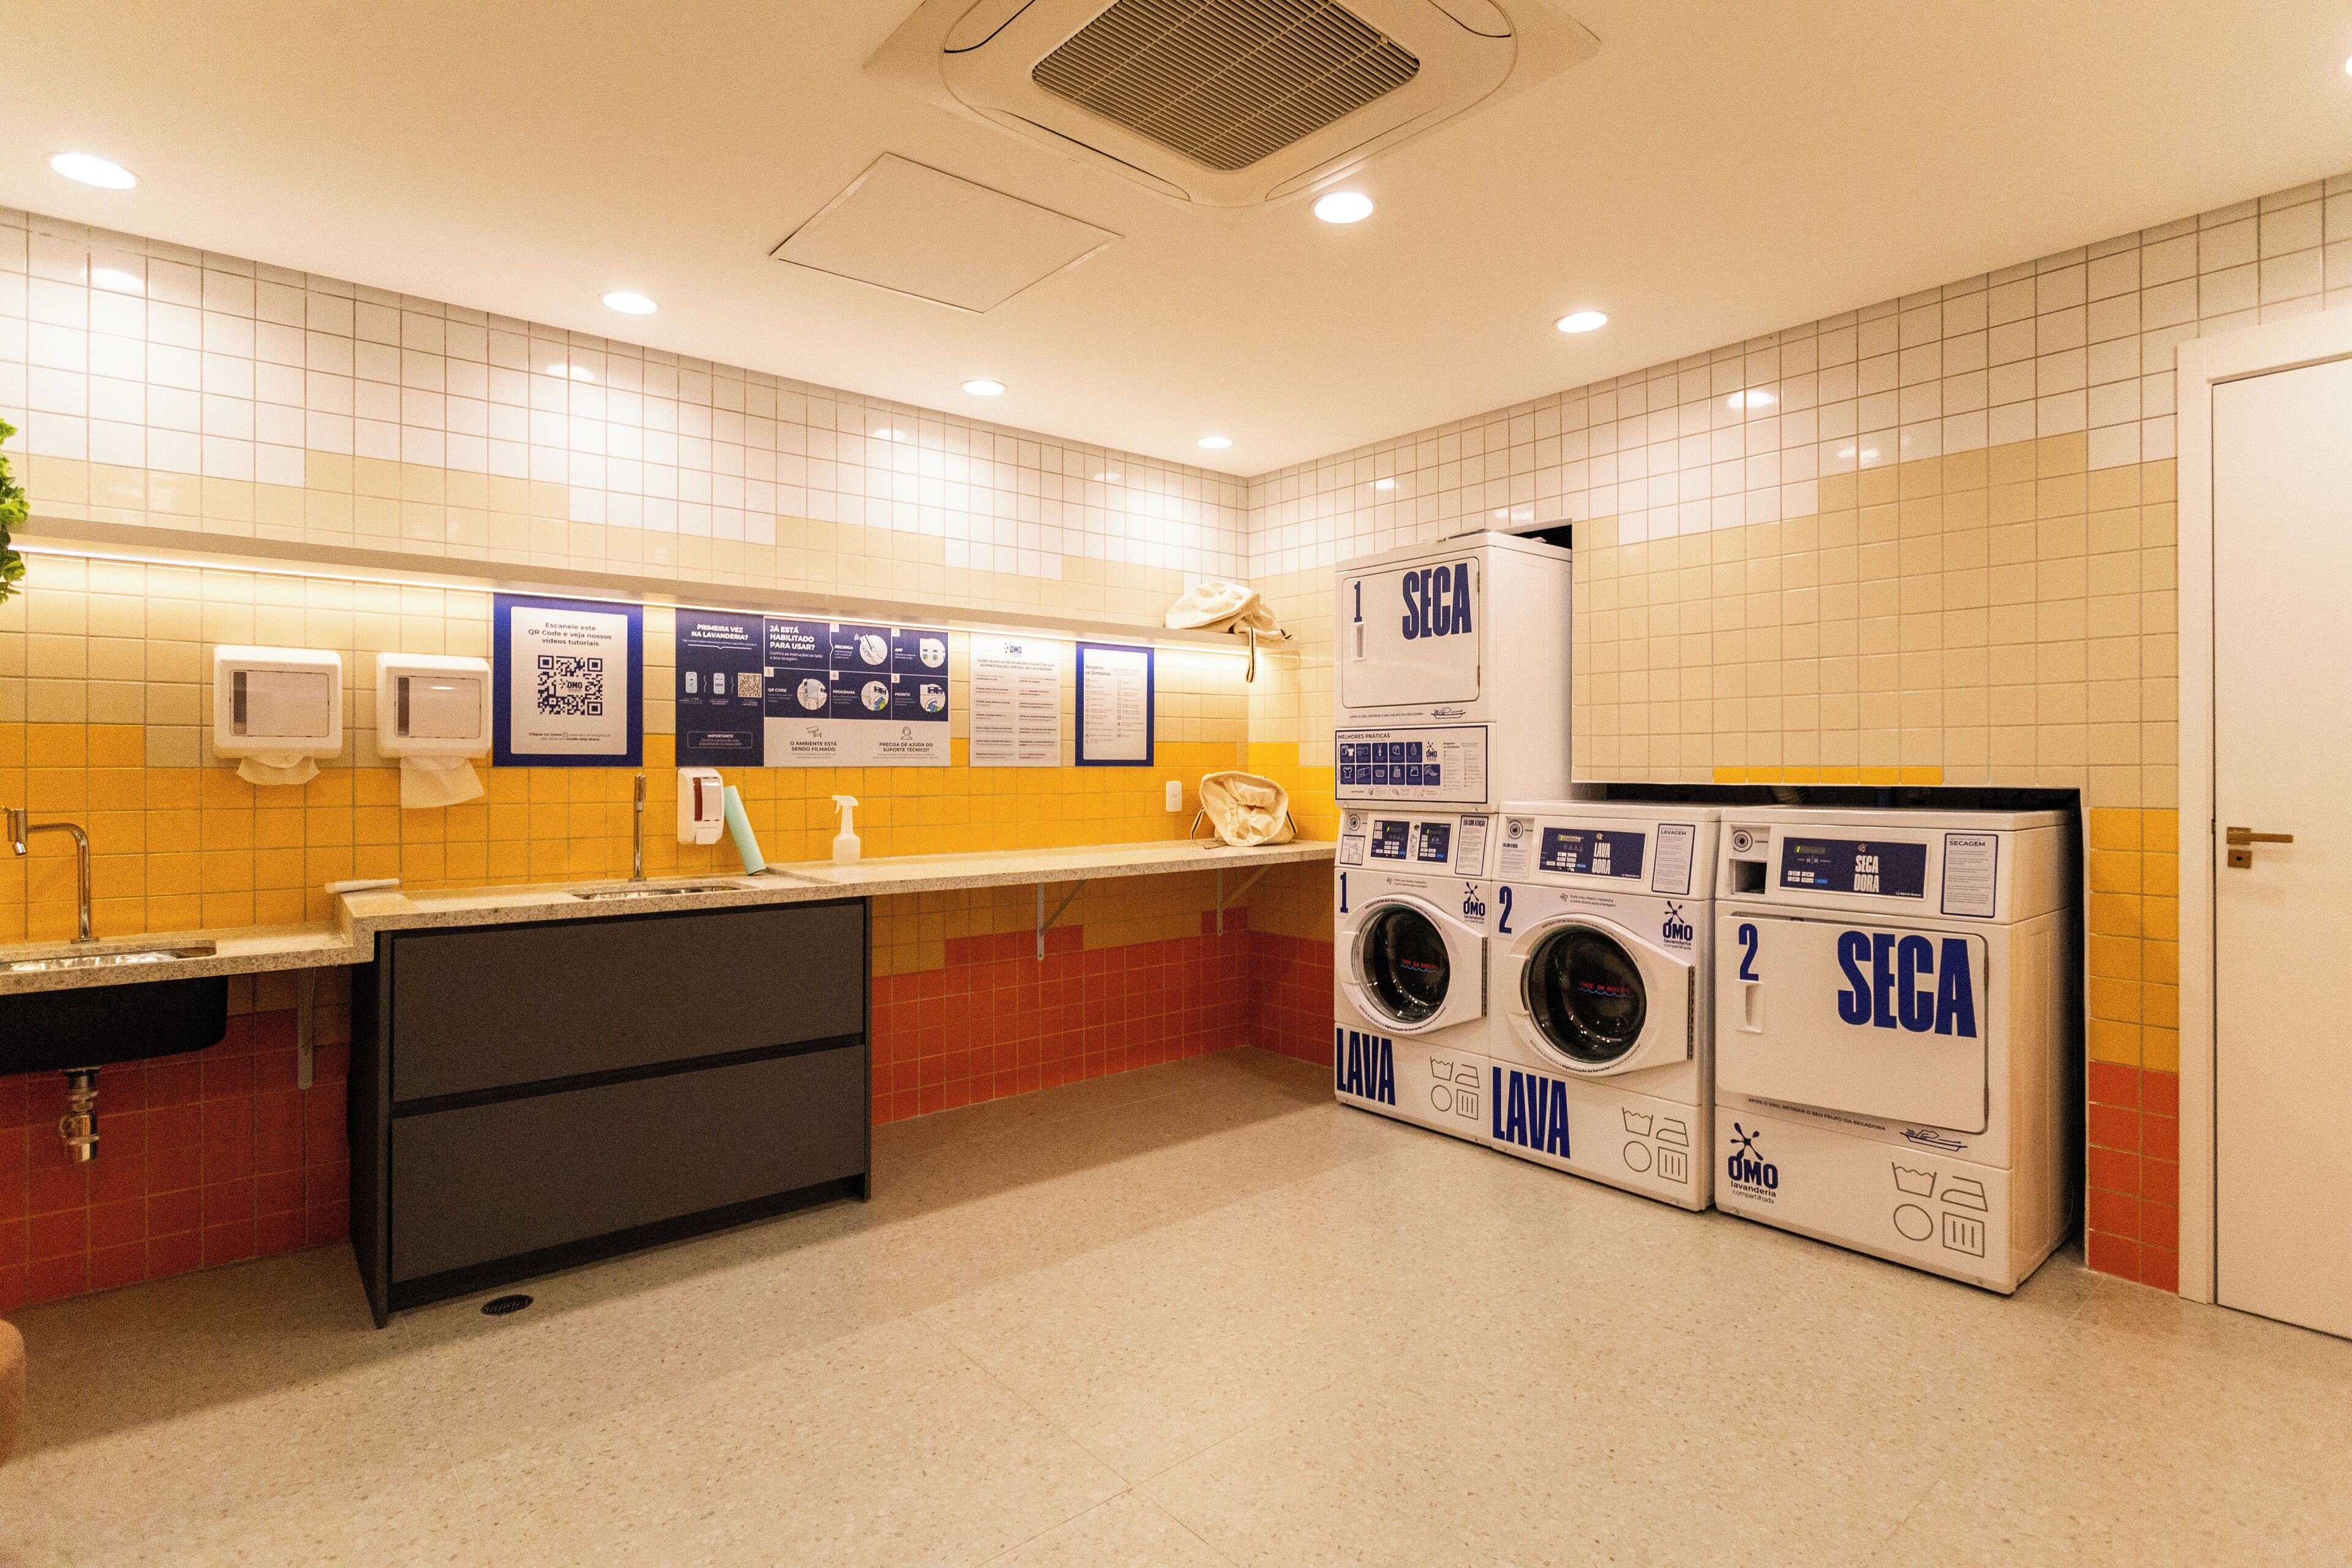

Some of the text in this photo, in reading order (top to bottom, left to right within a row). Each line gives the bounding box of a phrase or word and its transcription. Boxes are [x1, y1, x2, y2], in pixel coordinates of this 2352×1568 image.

[1354, 562, 1472, 640] 1 SECA
[703, 631, 748, 640] LAVANDERIA?
[770, 633, 814, 643] HABILITADO
[1593, 842, 1610, 858] LAVA
[1591, 858, 1611, 875] BORA
[1855, 854, 1879, 873] SECA
[1853, 873, 1879, 892] DORA
[1340, 872, 1348, 913] 1
[1463, 900, 1485, 916] OMO
[1498, 886, 1512, 935] 2
[1662, 922, 1693, 941] OMO
[1738, 923, 1977, 1038] 2 SECA
[1336, 1027, 1396, 1107] LAVA
[1492, 1066, 1570, 1159] LAVA
[1853, 1120, 1886, 1131] SECADORA
[1728, 1156, 1779, 1189] OMO
[1730, 1180, 1776, 1197] lavanderia
[1732, 1190, 1774, 1204] compartilhada
